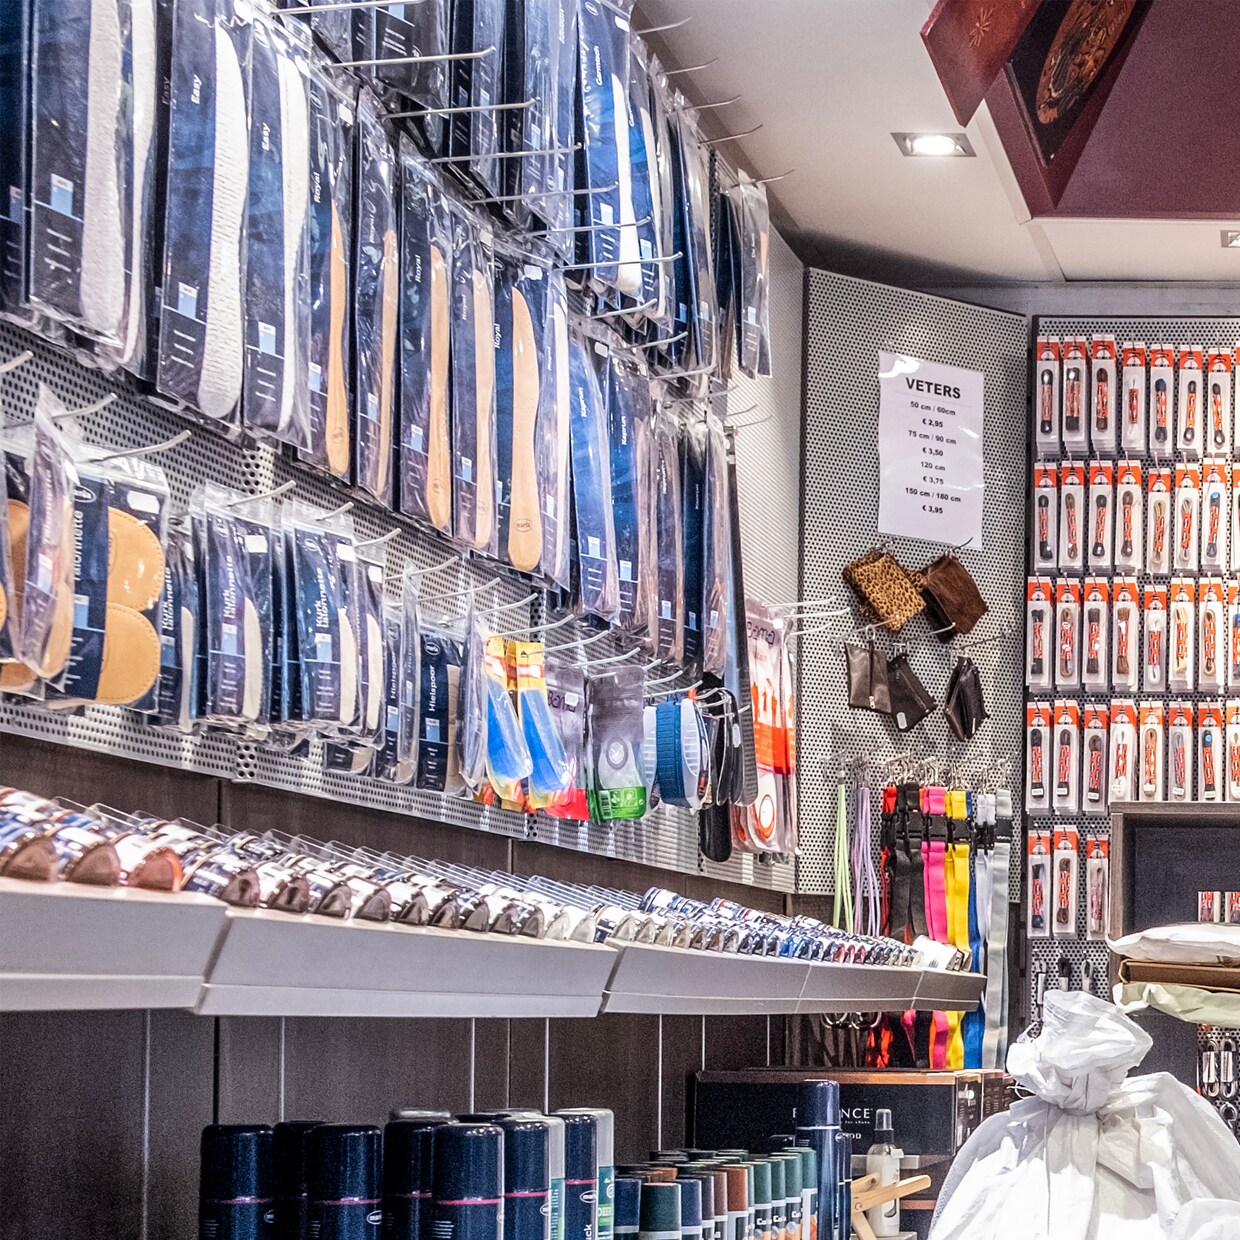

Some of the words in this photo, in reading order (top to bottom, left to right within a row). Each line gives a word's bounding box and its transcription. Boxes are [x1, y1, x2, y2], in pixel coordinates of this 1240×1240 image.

[191, 74, 203, 105] Easy
[262, 122, 271, 151] Easy
[314, 170, 322, 204] Royal
[414, 254, 422, 283] Royal
[905, 377, 961, 400] VETERS
[578, 386, 587, 418] Kaprun
[910, 400, 919, 409] 50
[921, 404, 932, 412] cm
[928, 418, 944, 429] 2,95
[908, 429, 917, 438] 75
[918, 433, 930, 441] cm
[935, 435, 945, 443] 90
[946, 438, 957, 446] cm
[928, 447, 944, 457] 3,50
[920, 461, 933, 470] 120
[934, 464, 946, 472] cm
[929, 476, 944, 486] 3,75
[905, 487, 918, 496] 150
[919, 490, 931, 498] cm
[936, 492, 949, 502] 180
[950, 495, 961, 503] cm
[928, 505, 944, 515] 3,95
[428, 664, 436, 713] Hielspoor
